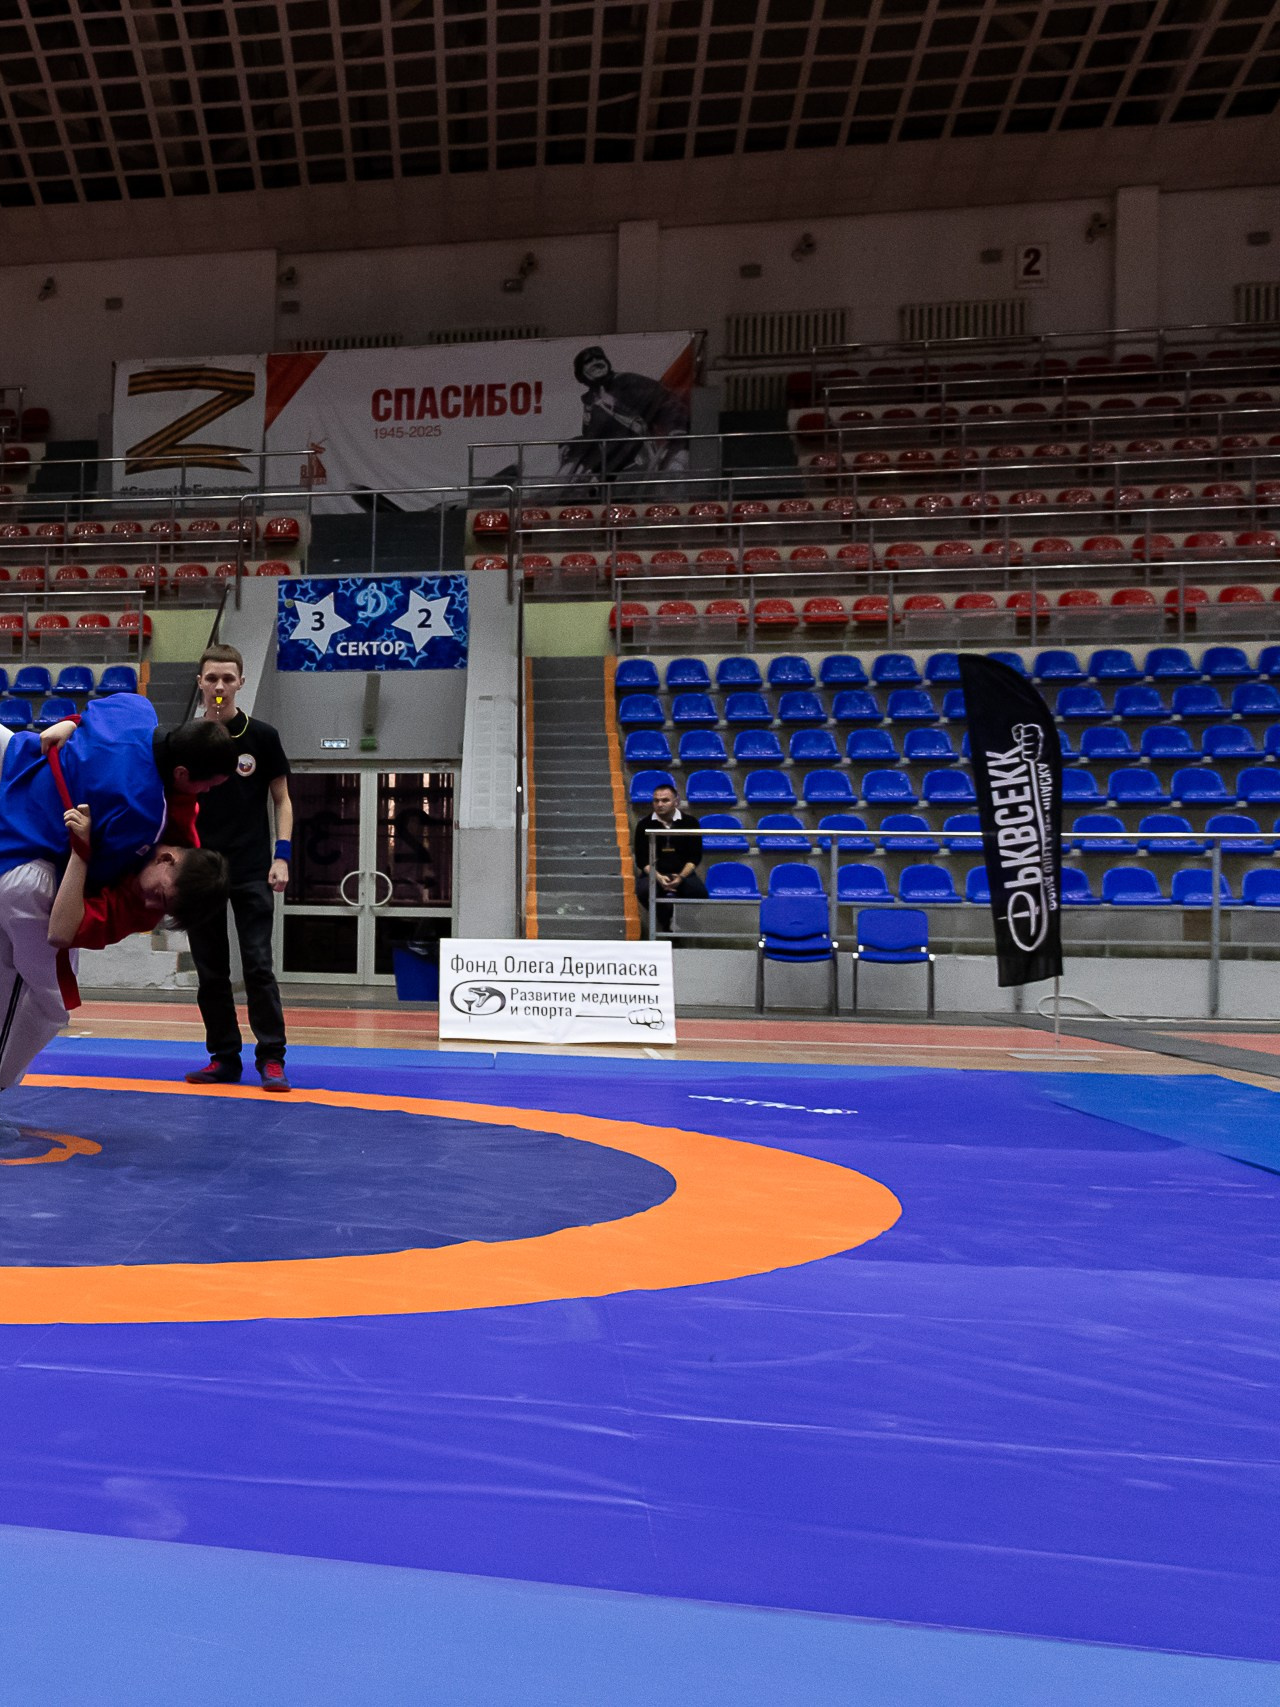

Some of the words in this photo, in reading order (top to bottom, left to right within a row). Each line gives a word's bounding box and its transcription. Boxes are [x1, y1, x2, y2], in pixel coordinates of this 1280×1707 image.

[1023, 248, 1041, 275] 2
[371, 381, 543, 422] СПАСИБО!
[125, 367, 255, 475] Z
[373, 425, 441, 439] 1945-2025
[311, 611, 325, 631] 3
[417, 608, 432, 628] 2
[335, 640, 405, 656] СЕКТОР
[451, 954, 498, 975] Фонд
[505, 955, 555, 975] Олега
[560, 956, 658, 978] Дерипаска
[510, 988, 576, 1003] Развитие
[582, 993, 659, 1006] медицины
[510, 1006, 519, 1016] и
[524, 1006, 572, 1019] спорта
